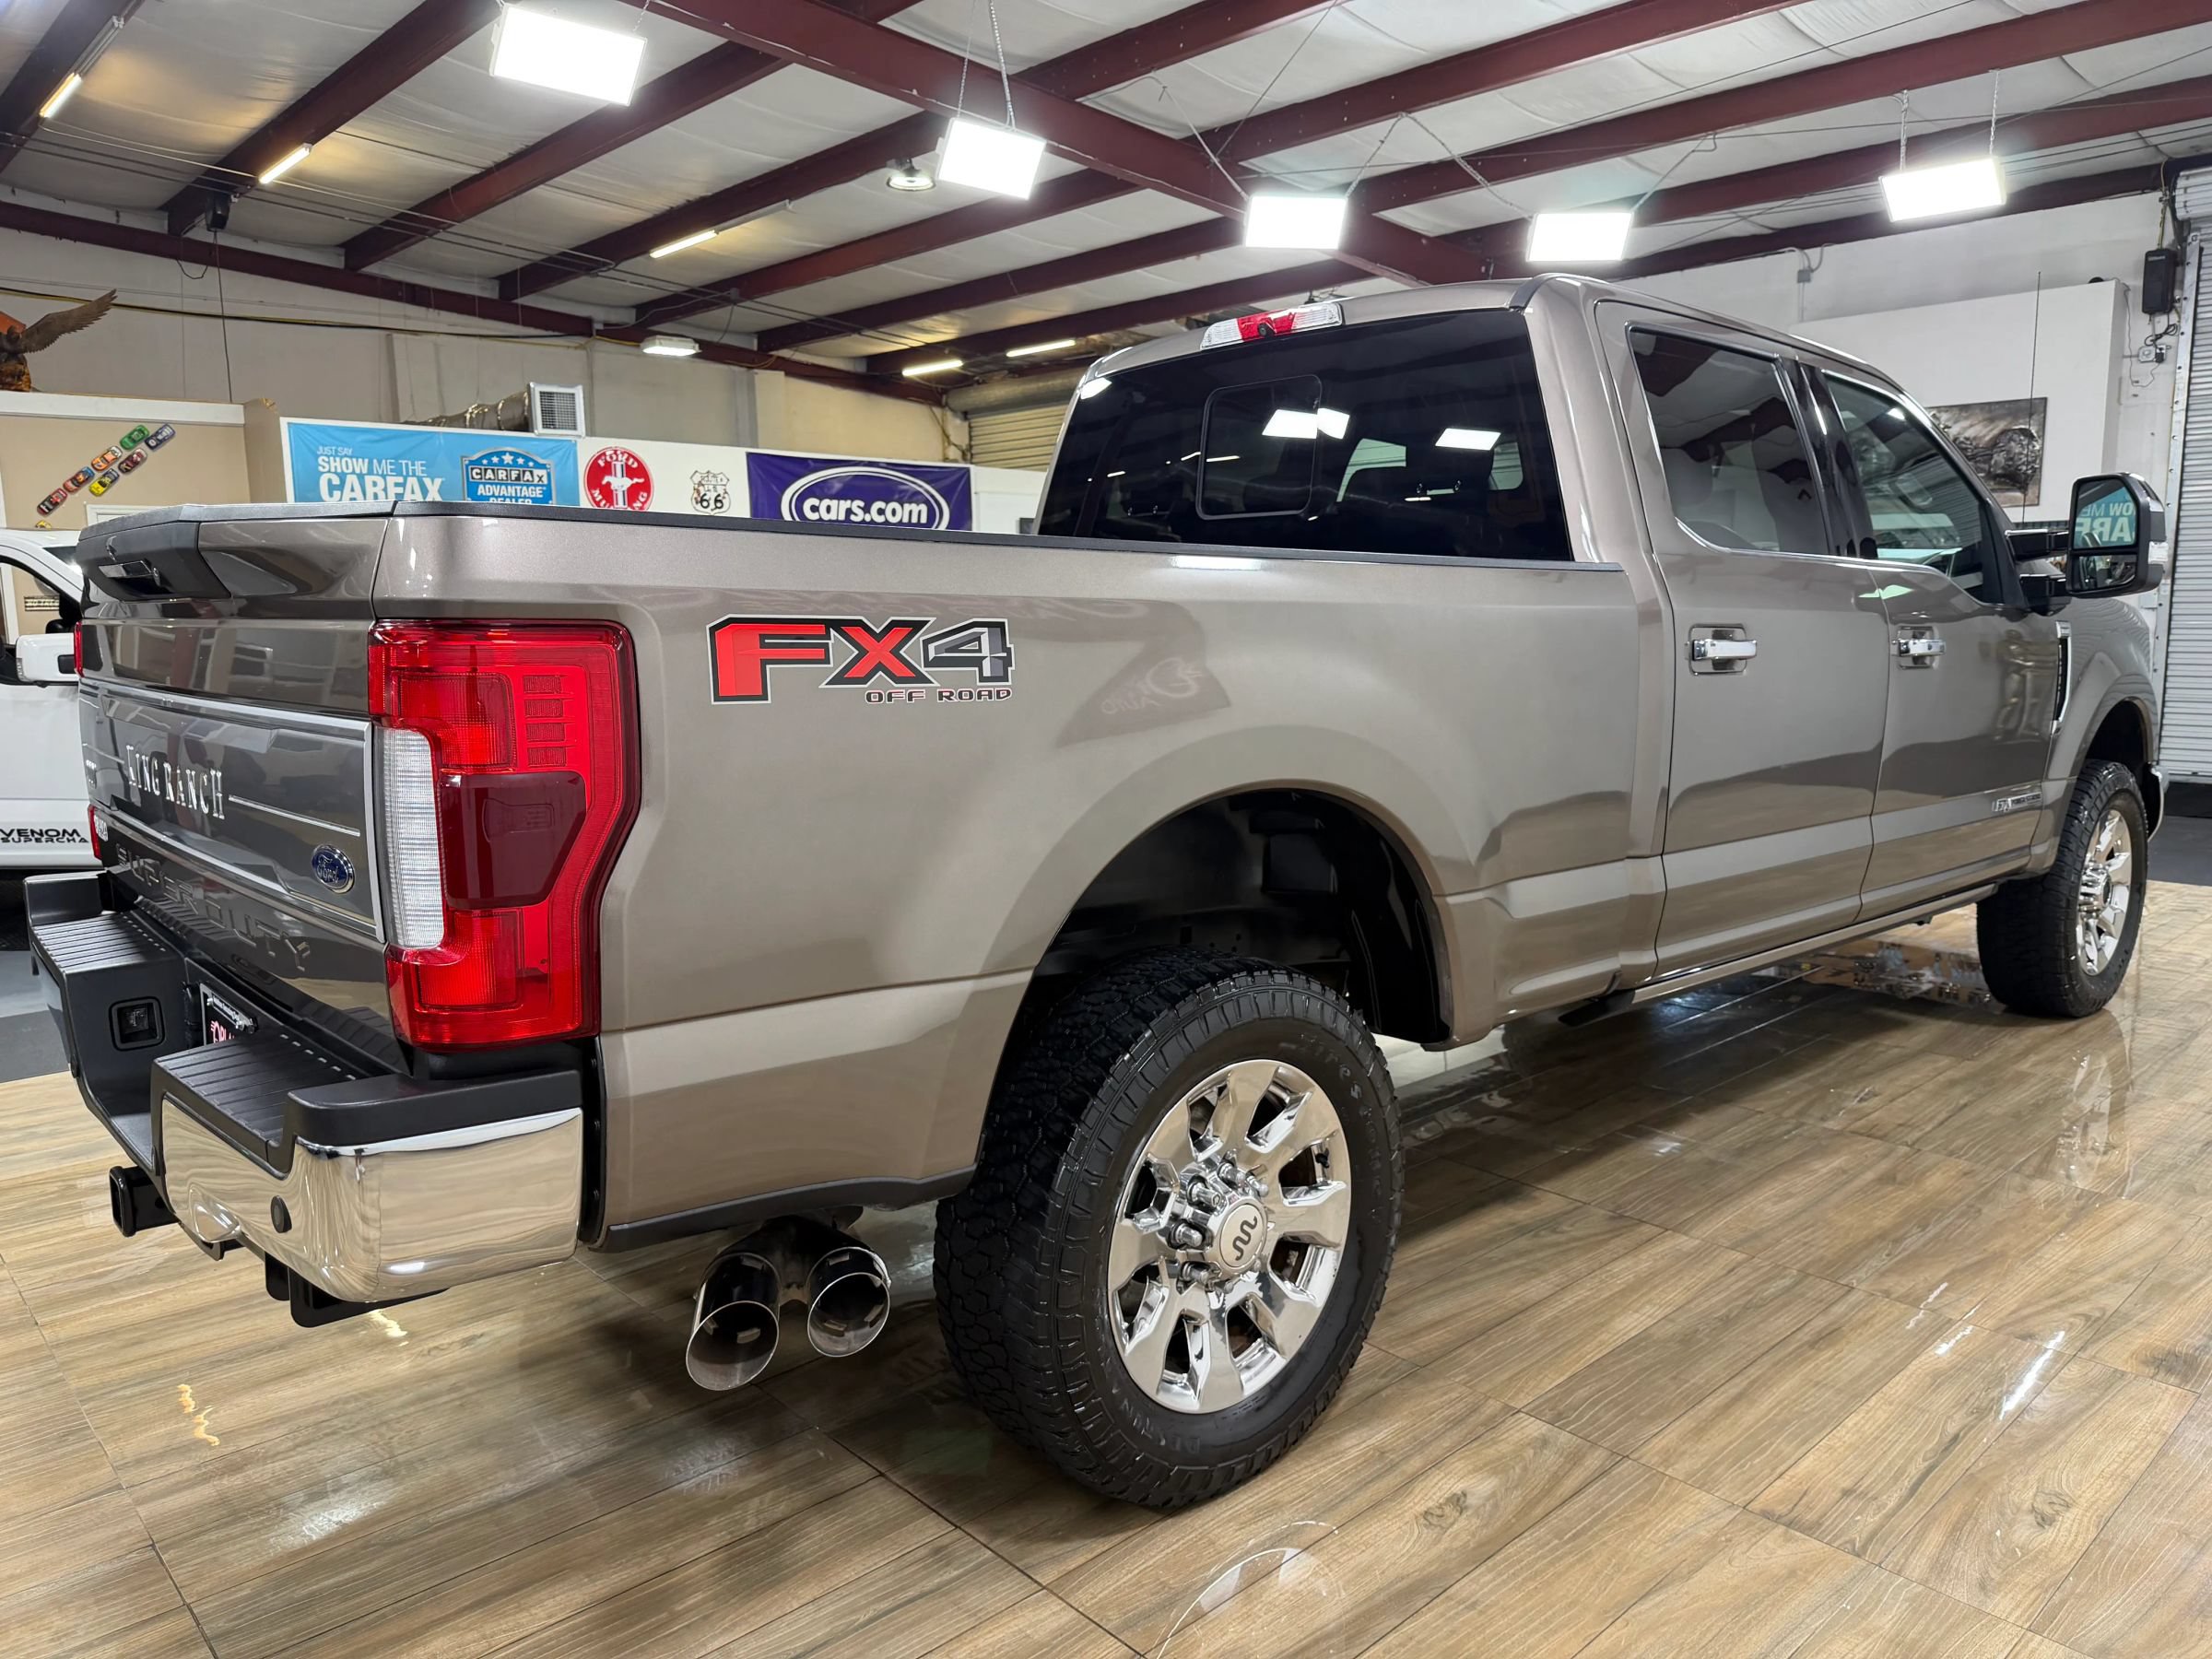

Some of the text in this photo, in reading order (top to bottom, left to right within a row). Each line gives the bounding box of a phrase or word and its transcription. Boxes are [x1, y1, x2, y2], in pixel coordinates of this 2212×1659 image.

[317, 446, 353, 455] JUST SAY
[597, 450, 639, 468] FORD
[317, 456, 427, 477] SHOW ME THE
[471, 467, 545, 484] CARFAX
[319, 472, 443, 501] CARFAX
[477, 484, 544, 498] ADVANTAGE
[700, 493, 724, 510] 66
[803, 498, 928, 524] cars.com
[706, 614, 1016, 704] FX4
[865, 688, 1011, 704] OFF ROAD
[125, 745, 161, 796] KING
[163, 759, 226, 820] RANCH
[0, 828, 81, 838] VENOM
[205, 898, 312, 972] DUTY
